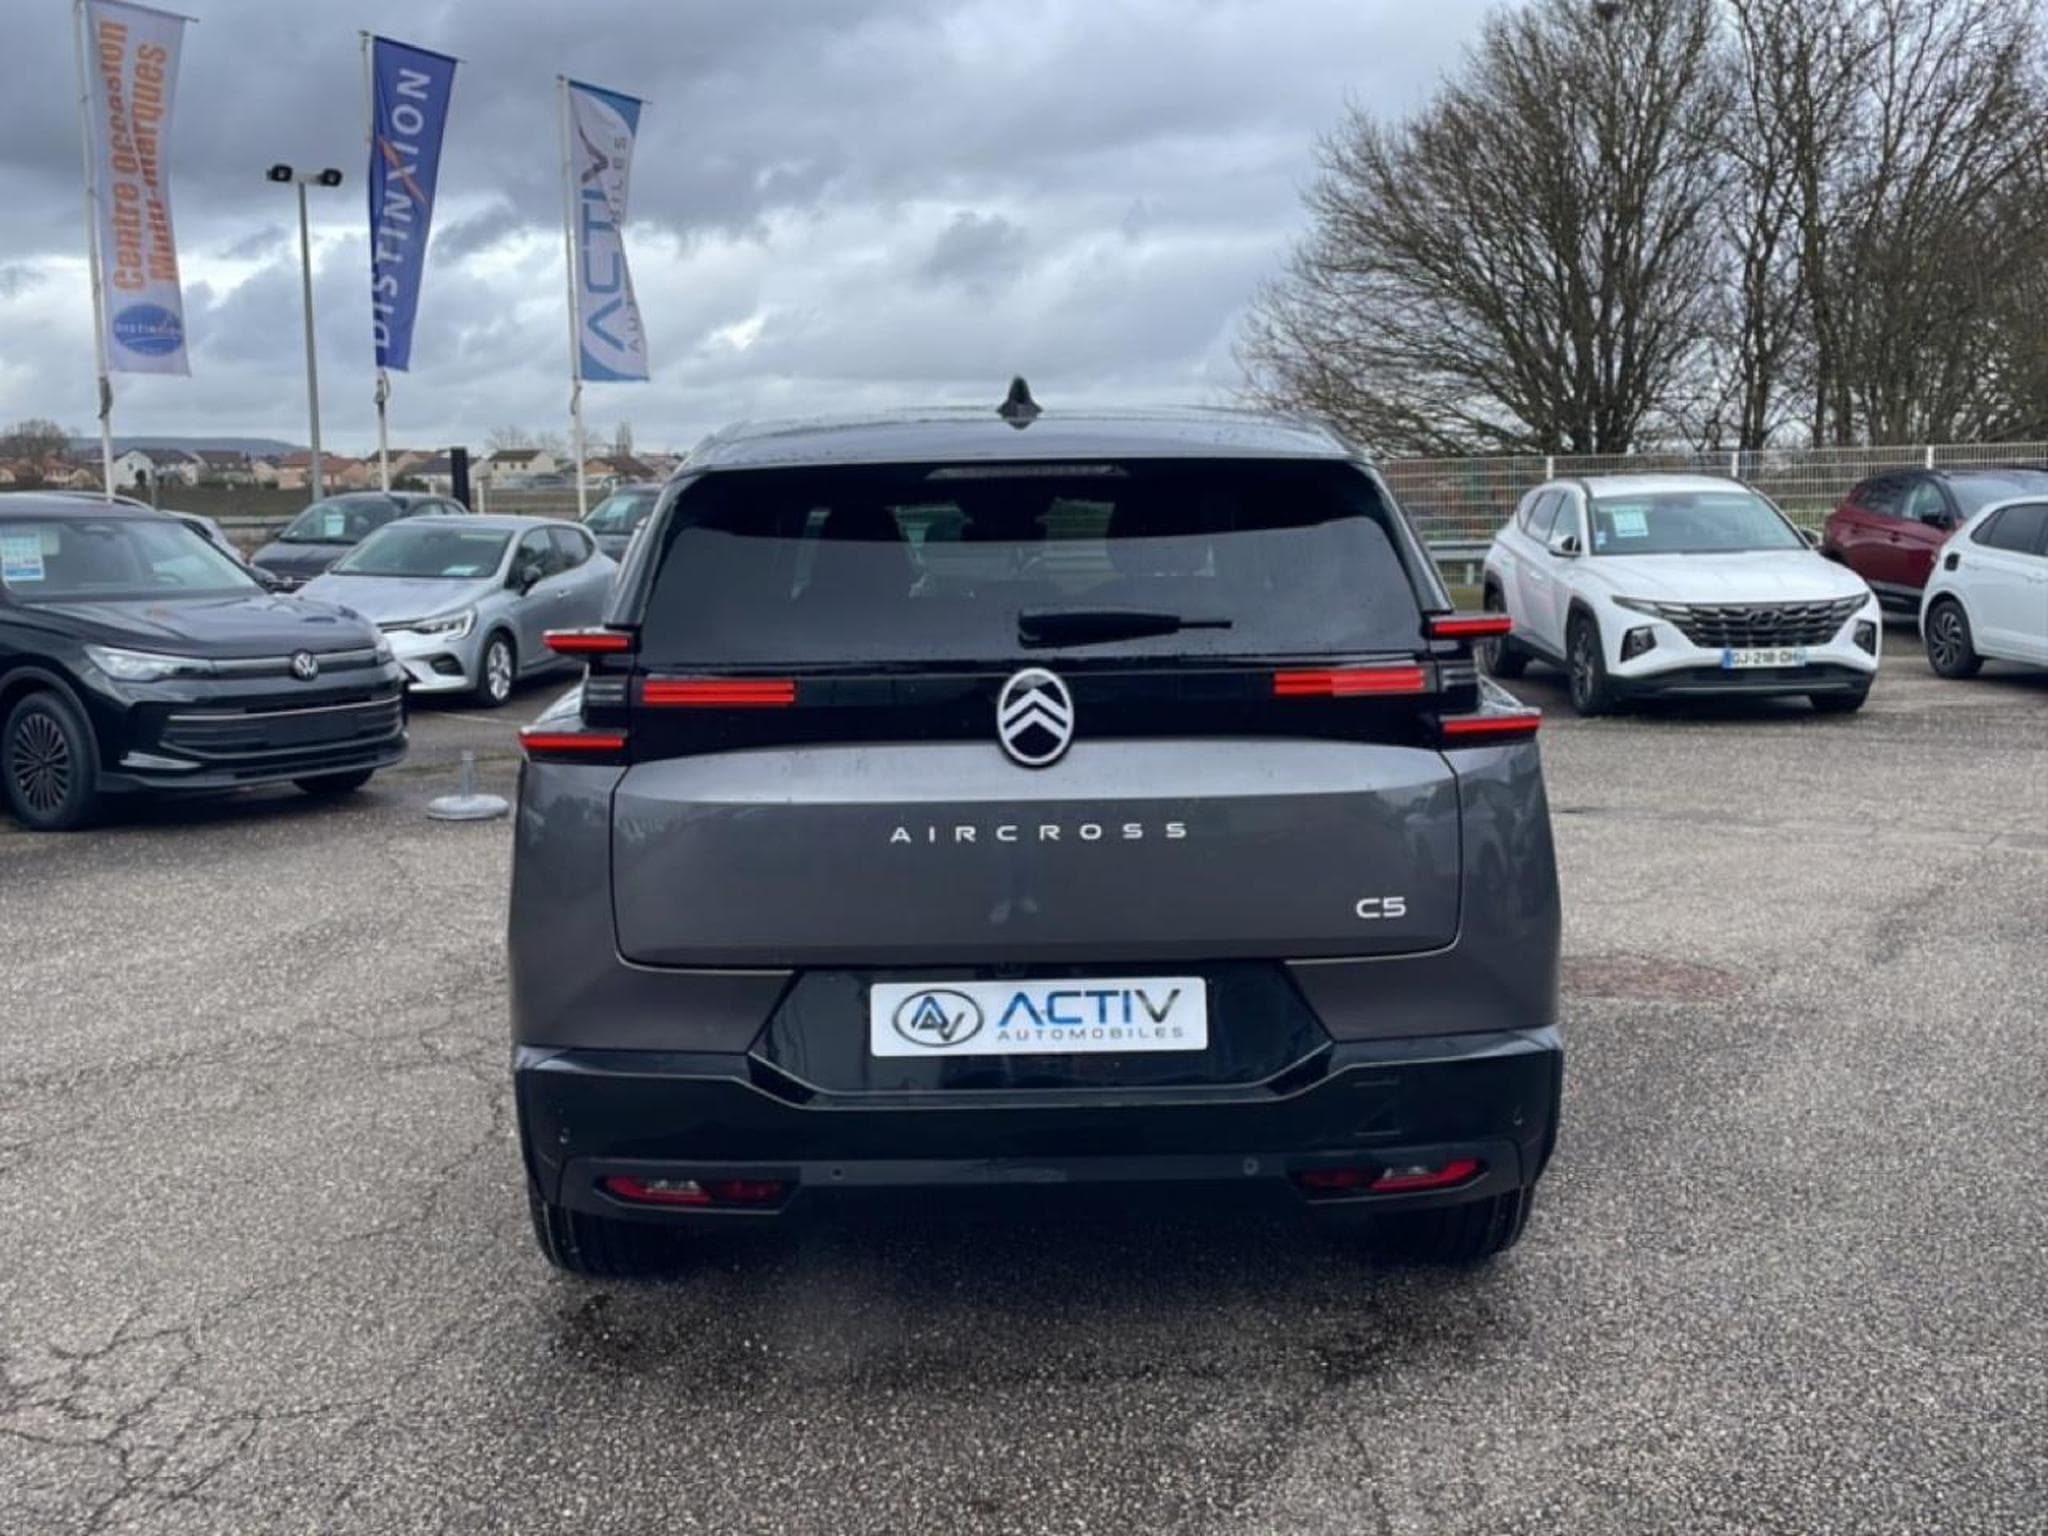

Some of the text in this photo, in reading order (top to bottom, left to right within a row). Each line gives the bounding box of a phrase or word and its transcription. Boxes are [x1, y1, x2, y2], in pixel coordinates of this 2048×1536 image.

[374, 68, 431, 348] DISTINXION
[113, 180, 145, 290] Centre
[578, 124, 625, 352] ACTIV
[890, 822, 1187, 843] AIRCROSS
[1355, 896, 1407, 919] C5
[997, 989, 1182, 1027] ACTIV
[996, 1026, 1184, 1041] AUTOMOBILES
